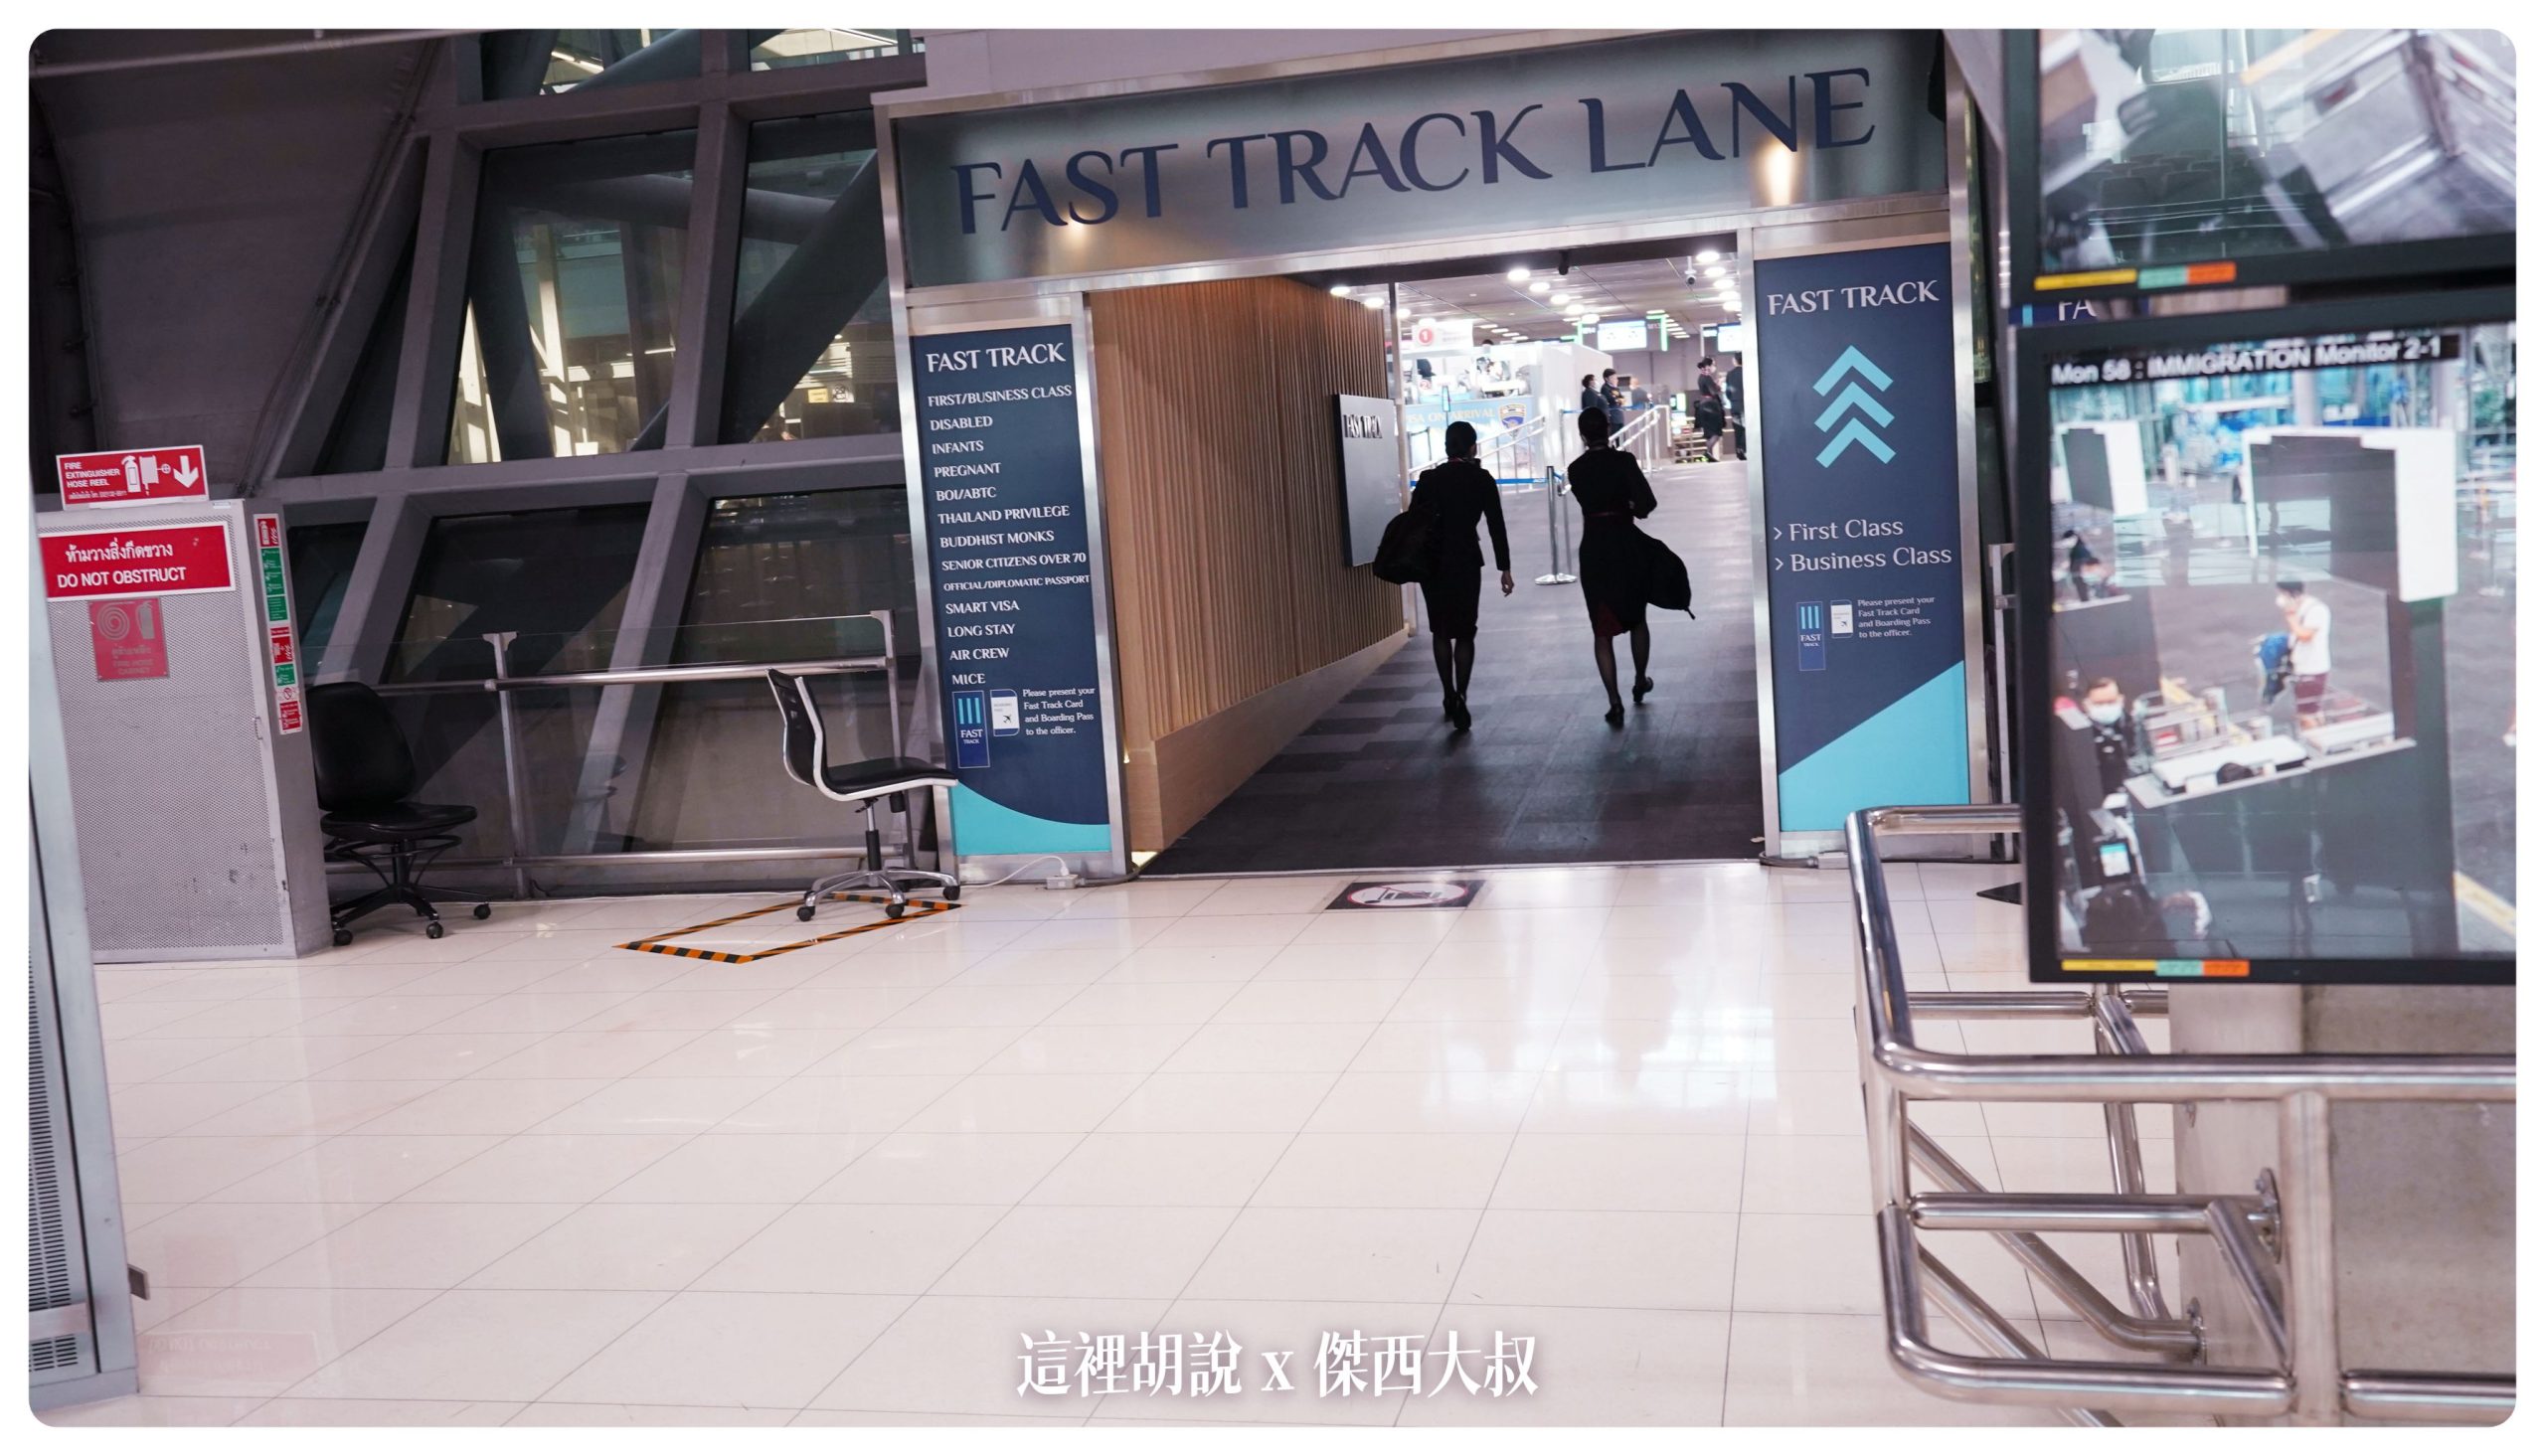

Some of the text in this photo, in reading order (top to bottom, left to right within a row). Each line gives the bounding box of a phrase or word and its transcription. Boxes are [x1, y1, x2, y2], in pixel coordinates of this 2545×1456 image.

[949, 67, 1876, 236] FAST TRACK LANE
[1768, 279, 1940, 315] FAST TRACK
[927, 343, 1066, 373] FAST TRACK
[2051, 362, 2099, 386] Mon
[2147, 347, 2311, 378] IMMIGRATION
[2315, 338, 2399, 365] Monitor
[2403, 336, 2442, 359] 2-1
[928, 385, 1072, 406] FIRST/BUSINESS CLASS
[930, 415, 993, 430] DISABLED
[1429, 412, 1446, 422] ON
[1448, 408, 1495, 419] ARRIVAL
[932, 440, 984, 454] INFANTS
[66, 468, 120, 479] EXTINGUISHER
[933, 462, 1001, 477] PREGNANT
[89, 478, 110, 487] REEL
[935, 486, 997, 501] BOI/ABTC
[937, 505, 1070, 524] THAILAND PRIVILEGE
[1788, 519, 1904, 542] First Class
[939, 530, 1055, 548] BUDDHIST MONKS
[66, 537, 173, 564] ห้ามวางสิ่งกีดขวาง
[941, 553, 1087, 571] SENIOR CITIZENS OVER 70
[1790, 546, 1952, 572] Business Class
[57, 566, 187, 589] DO NOT OBSTRUCT
[943, 574, 1091, 591] OFFICIAL/DIPLOMATIC PASSPORT
[945, 600, 1020, 614] SMART VISA
[1884, 597, 1915, 607] present
[947, 623, 1016, 638] LONG STAY
[1875, 618, 1911, 628] Boarding
[949, 647, 1010, 661] AIR CREW
[951, 673, 986, 685] MICE
[1049, 688, 1076, 698] present
[1041, 701, 1063, 710] Track
[1041, 713, 1075, 723] Boarding
[1077, 712, 1095, 721] Pass
[960, 728, 982, 737] FAST
[1036, 727, 1049, 735] the
[1050, 726, 1076, 734] officer.
